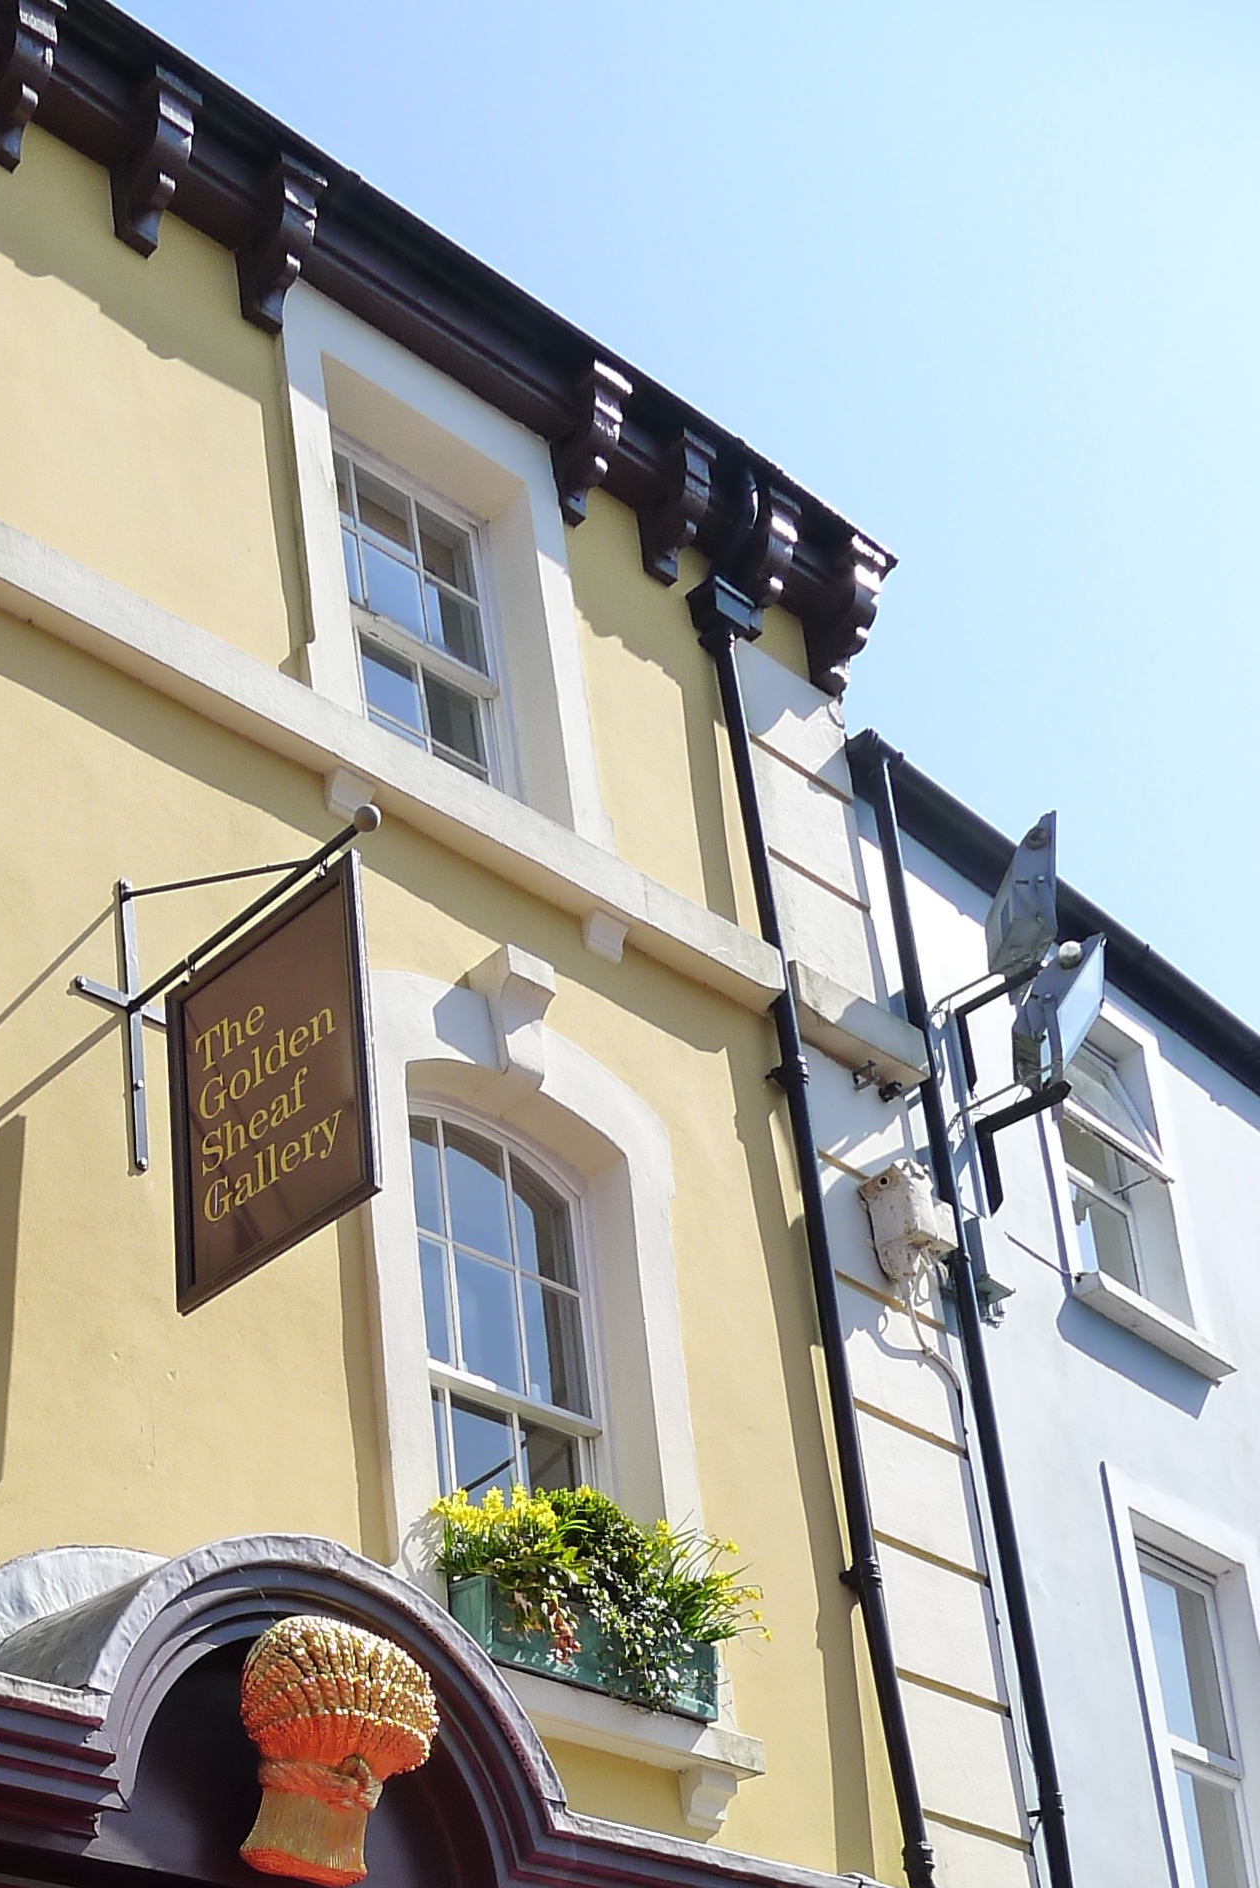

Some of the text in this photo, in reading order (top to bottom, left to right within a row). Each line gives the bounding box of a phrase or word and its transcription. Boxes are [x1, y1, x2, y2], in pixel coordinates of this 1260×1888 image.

[195, 1004, 265, 1072] The
[199, 1007, 336, 1120] Golden
[200, 1066, 309, 1176] Sheaf
[203, 1109, 343, 1223] Gallery
